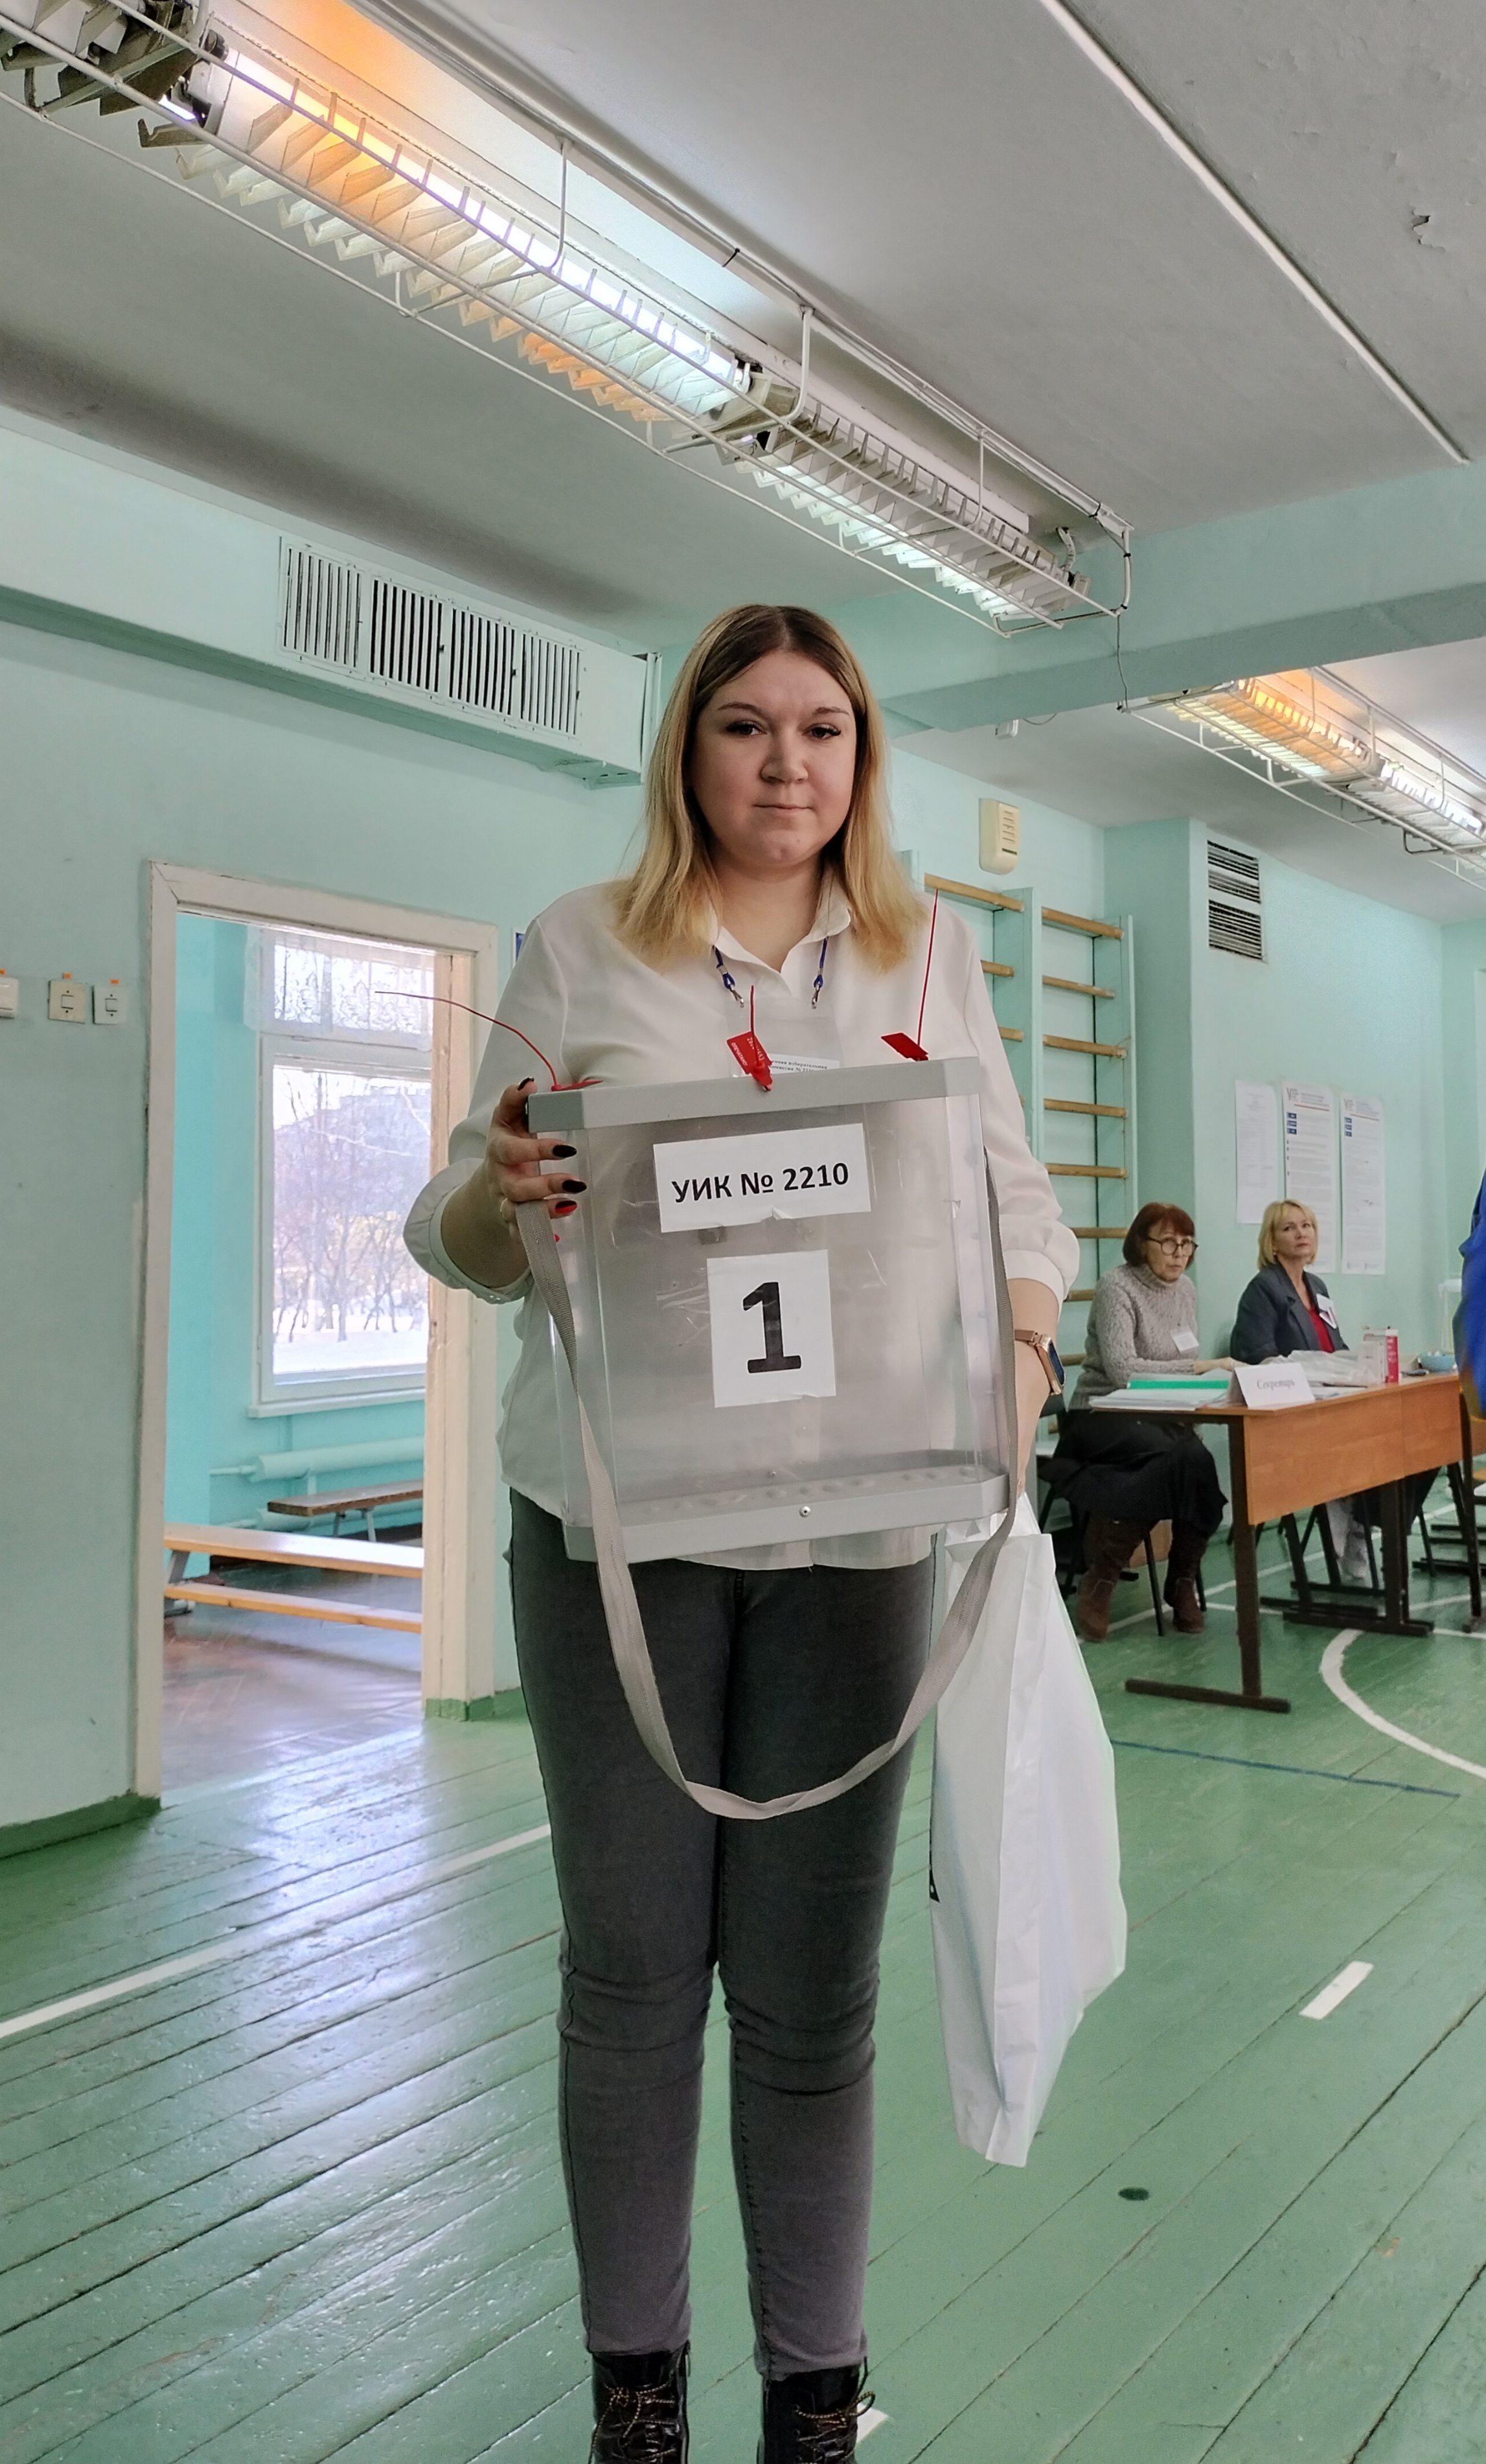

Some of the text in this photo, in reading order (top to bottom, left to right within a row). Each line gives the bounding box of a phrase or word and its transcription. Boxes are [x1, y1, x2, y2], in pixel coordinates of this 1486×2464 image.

[672, 1162, 849, 1203] УИК № 2210
[742, 1281, 802, 1374] 1
[1257, 1379, 1295, 1391] Секретарь
